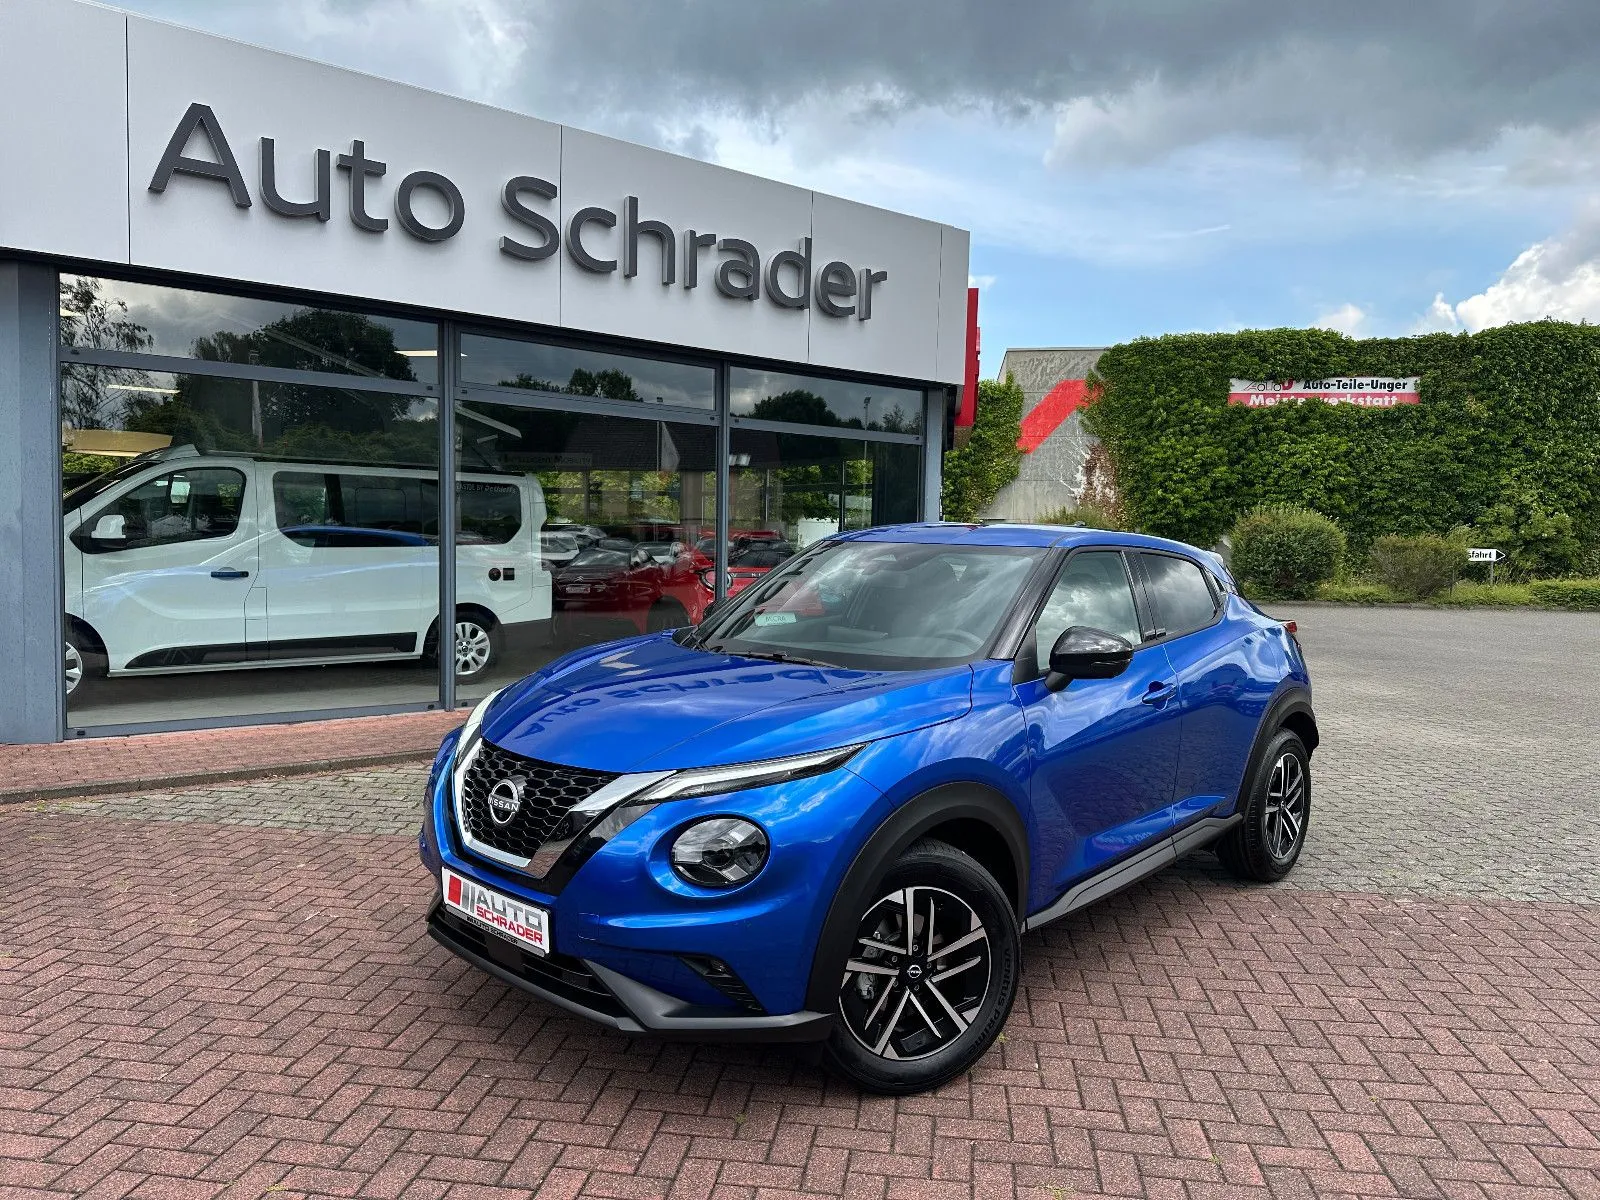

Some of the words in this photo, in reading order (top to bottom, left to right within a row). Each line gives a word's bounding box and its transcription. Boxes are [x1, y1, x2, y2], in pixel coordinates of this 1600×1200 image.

[148, 102, 465, 242] Auto
[500, 175, 888, 321] Schrader
[1303, 379, 1408, 392] Auto-Teile-Unger
[488, 796, 519, 812] NISSAN
[476, 889, 543, 932] AUTO
[476, 904, 543, 945] SCHRADER
